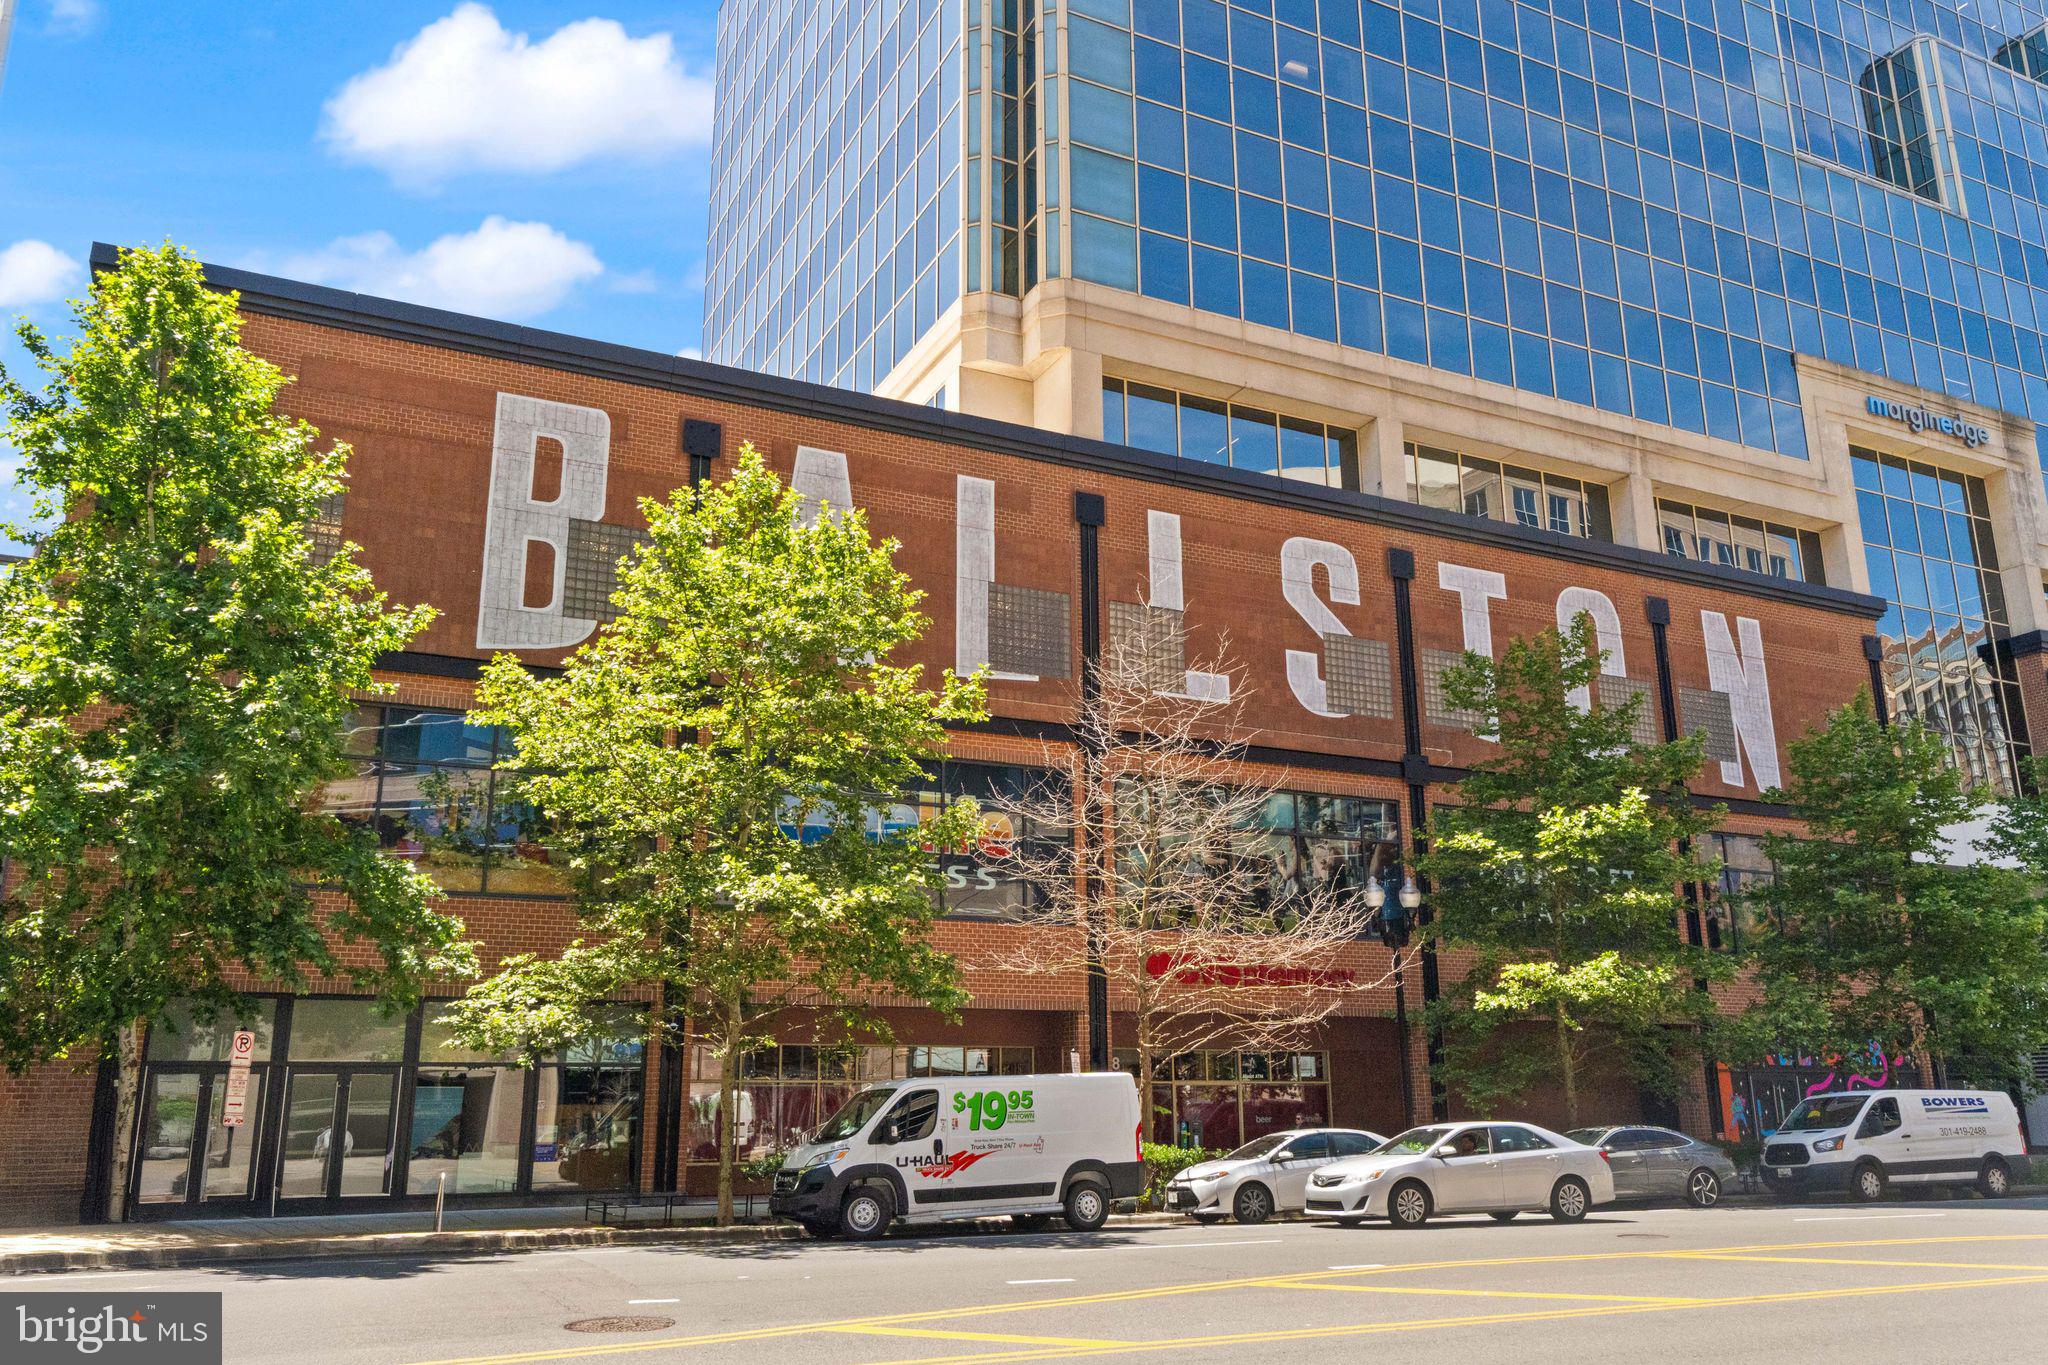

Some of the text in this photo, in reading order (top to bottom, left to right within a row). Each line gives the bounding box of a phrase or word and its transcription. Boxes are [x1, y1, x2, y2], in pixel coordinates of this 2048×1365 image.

[1866, 395, 1990, 448] marginedge
[1921, 1097, 1985, 1107] BOWERS
[1004, 1141, 1017, 1149] 24/7
[896, 1153, 953, 1168] U-HAUL
